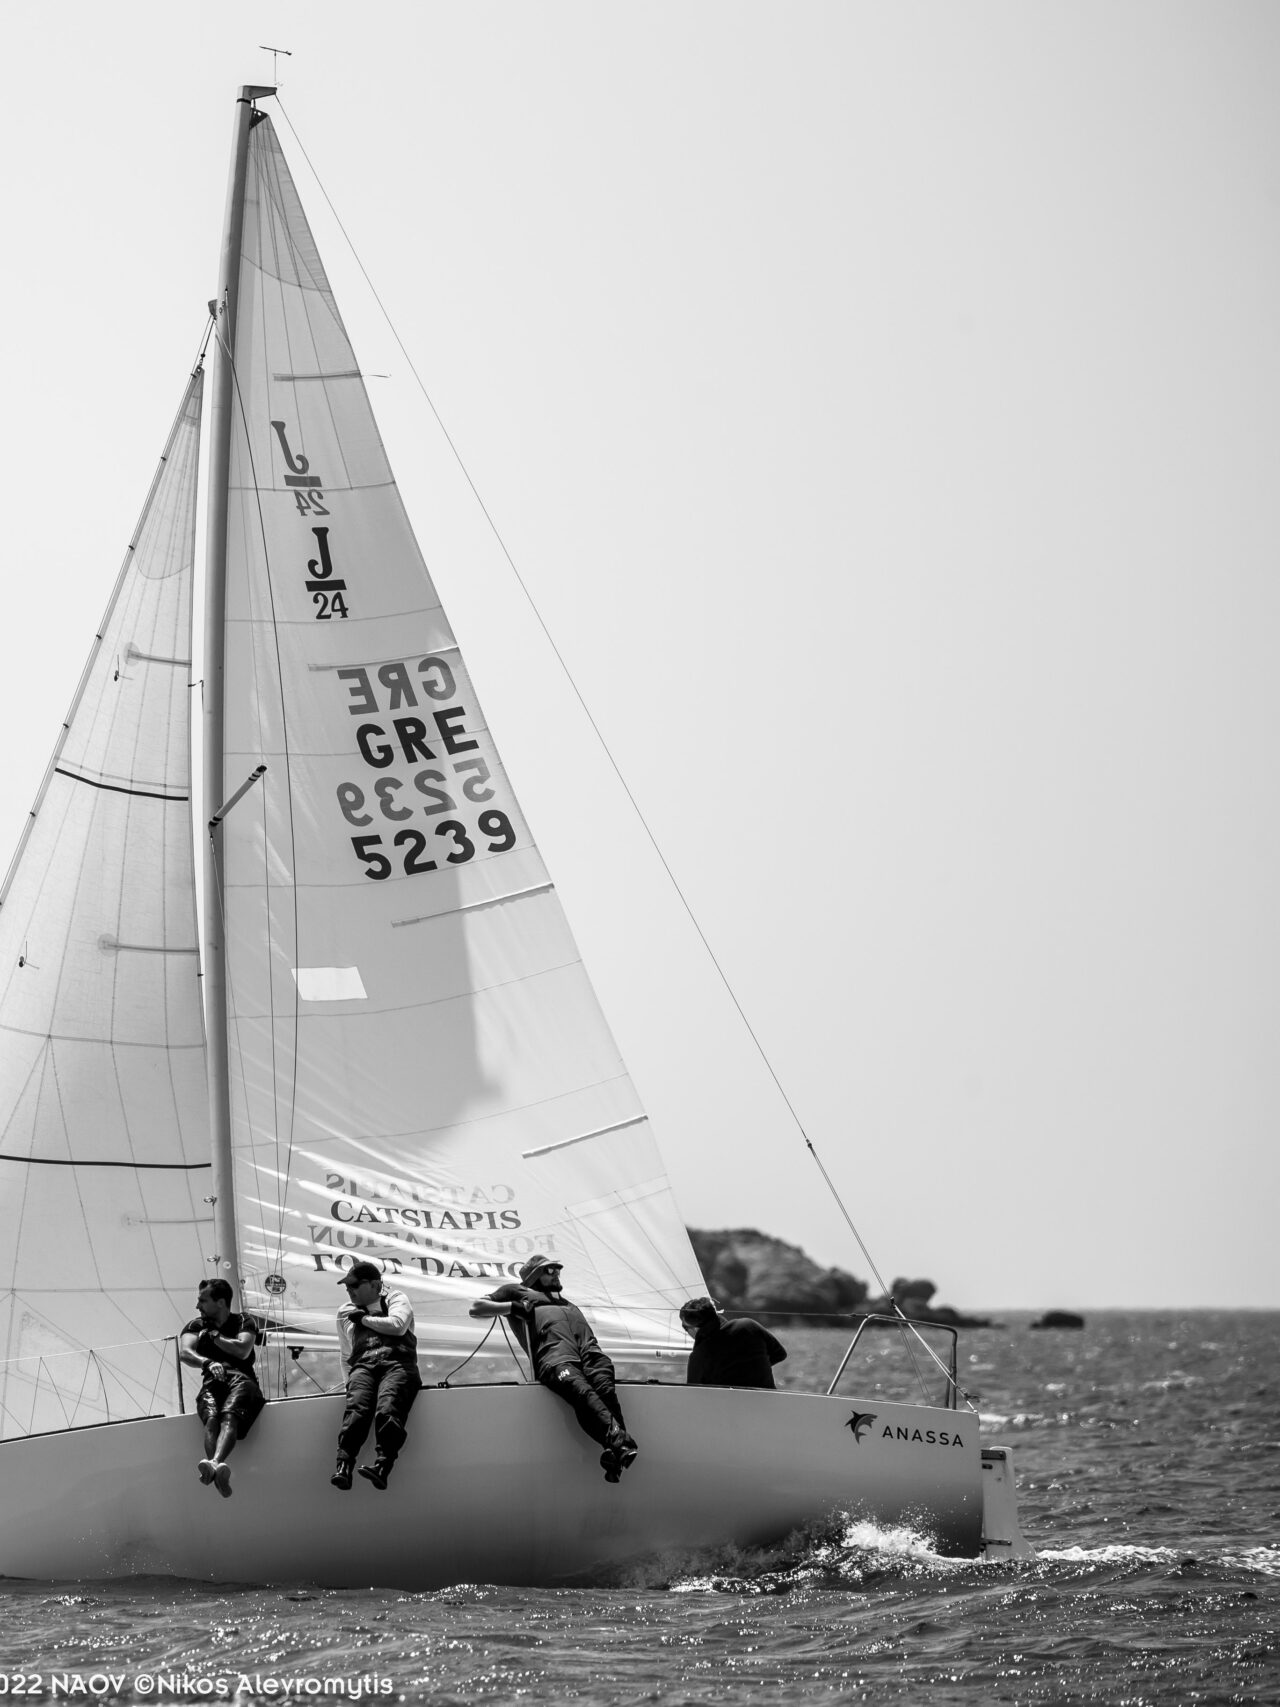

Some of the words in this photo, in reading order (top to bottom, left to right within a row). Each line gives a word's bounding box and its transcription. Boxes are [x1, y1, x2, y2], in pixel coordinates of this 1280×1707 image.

[307, 526, 333, 580] J
[312, 591, 349, 620] 24
[356, 706, 480, 769] GRE
[350, 809, 517, 881] 5239
[330, 1200, 522, 1230] CATSIAPIS
[881, 1425, 964, 1448] ANASSA
